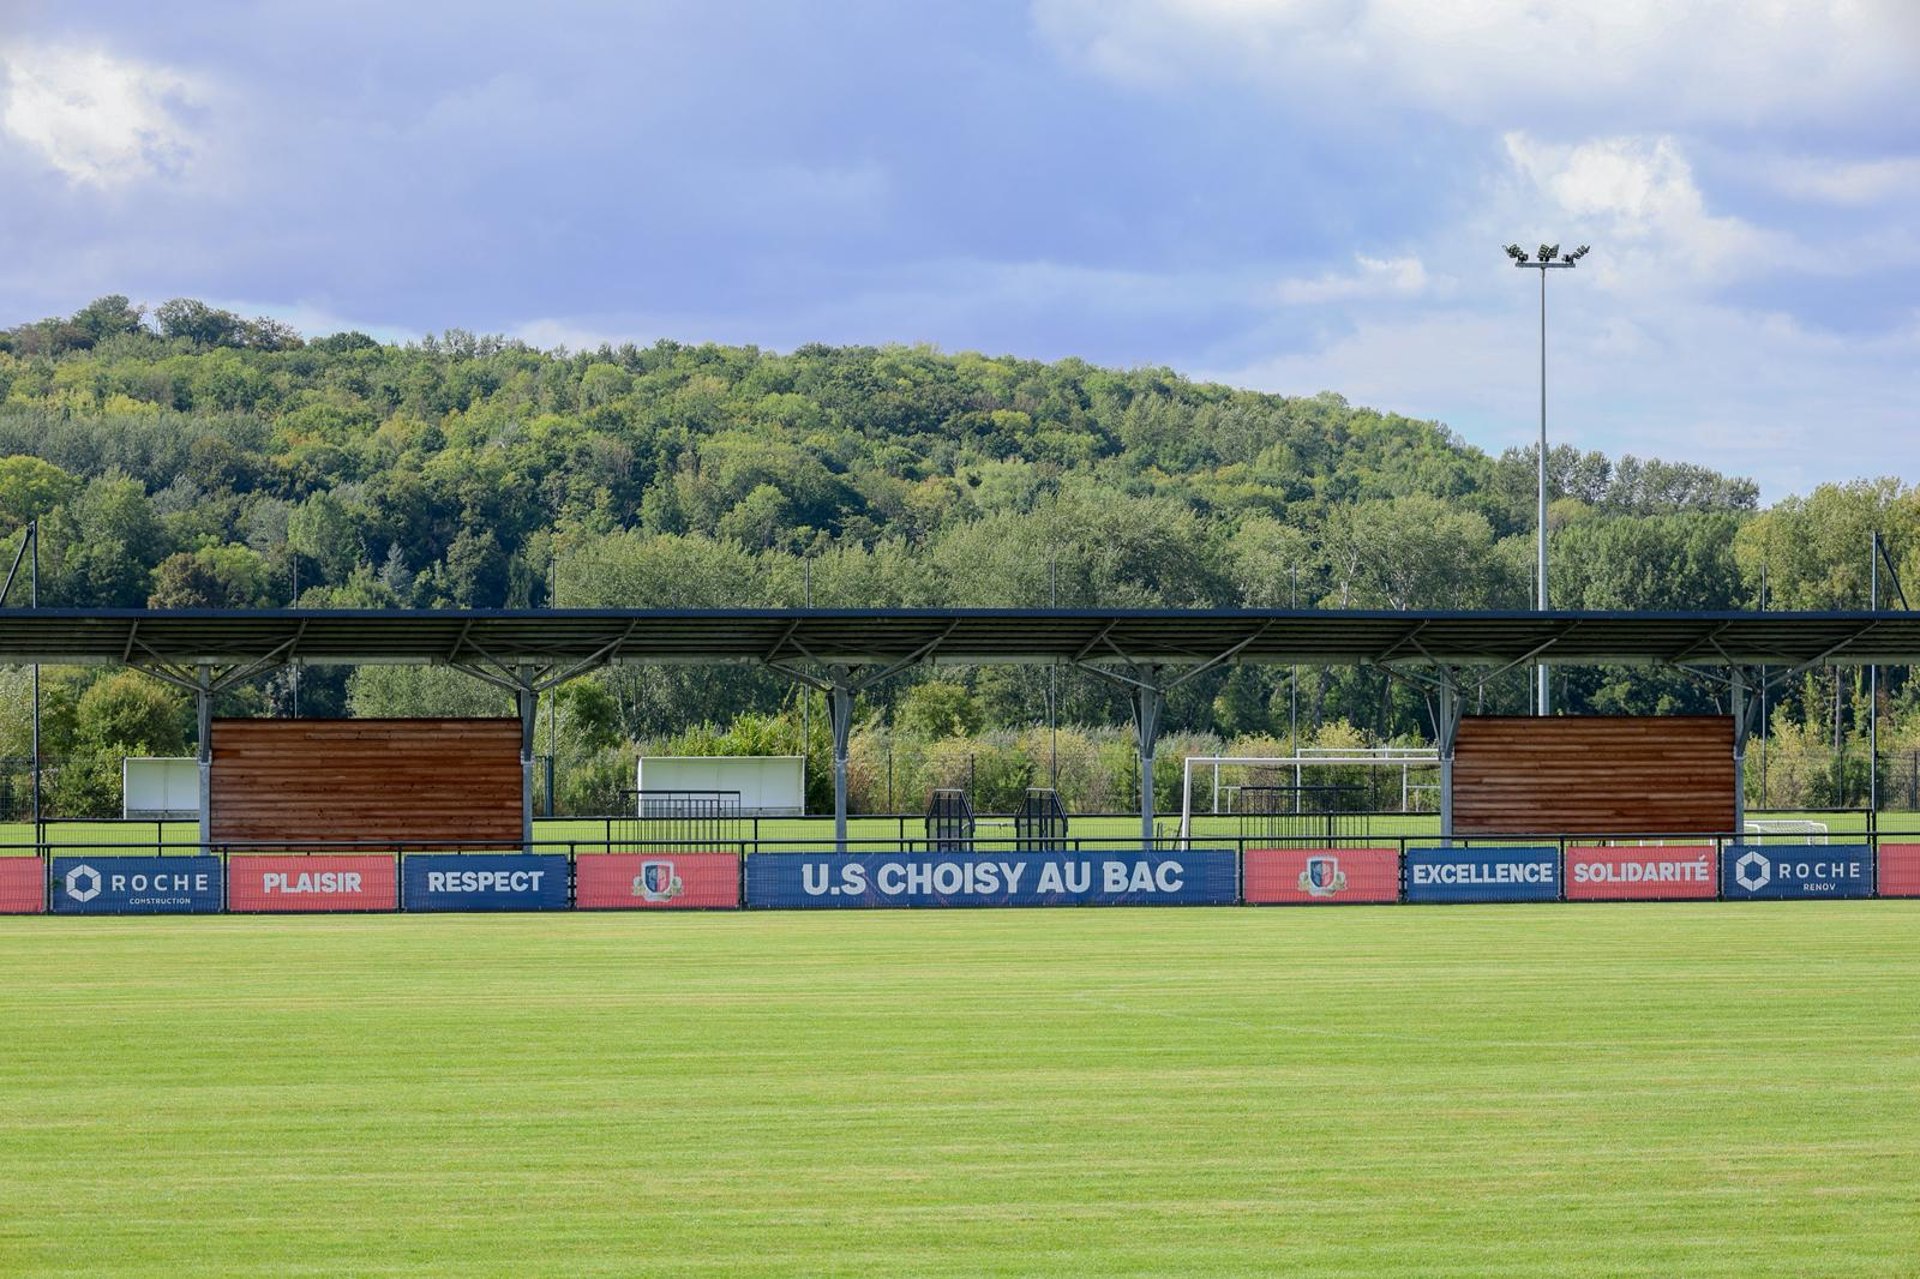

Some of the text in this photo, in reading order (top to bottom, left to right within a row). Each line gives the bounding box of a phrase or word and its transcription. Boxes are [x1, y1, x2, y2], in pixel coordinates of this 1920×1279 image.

[802, 861, 1184, 895] U.S CHOISY AU BAC
[1413, 863, 1553, 884] EXCELLENCE
[1573, 855, 1710, 882] SOLIDARITÉ
[1778, 862, 1861, 879] ROCHE
[111, 874, 209, 891] ROCHE
[263, 872, 362, 893] PLAISIR
[428, 871, 544, 892] RESPECT
[1803, 883, 1836, 891] RENOV
